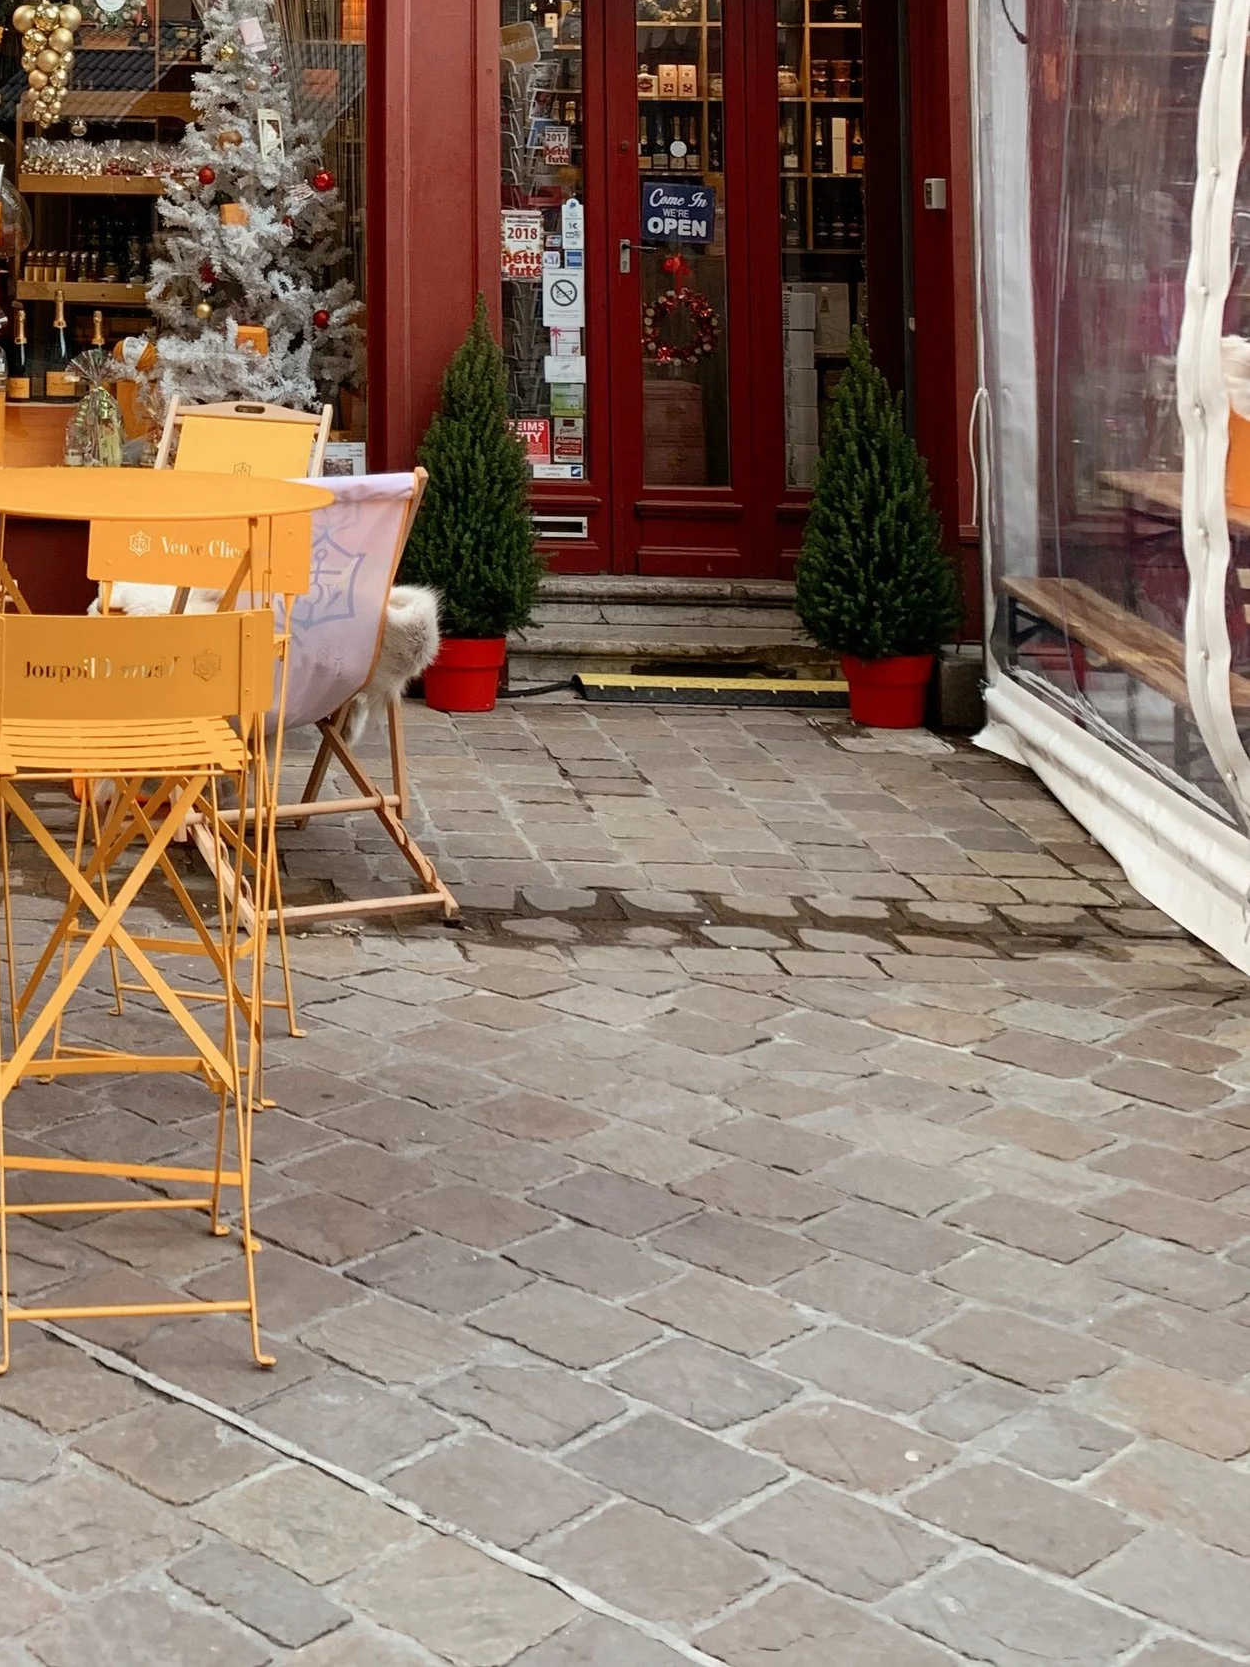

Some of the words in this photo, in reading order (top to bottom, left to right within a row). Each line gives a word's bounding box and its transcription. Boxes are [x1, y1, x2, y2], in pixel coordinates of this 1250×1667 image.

[649, 187, 686, 208] Come
[687, 191, 708, 208] In
[662, 207, 690, 219] WE'RE
[507, 227, 538, 240] 2018
[647, 216, 707, 238] OPEN
[161, 535, 203, 555] Veuve
